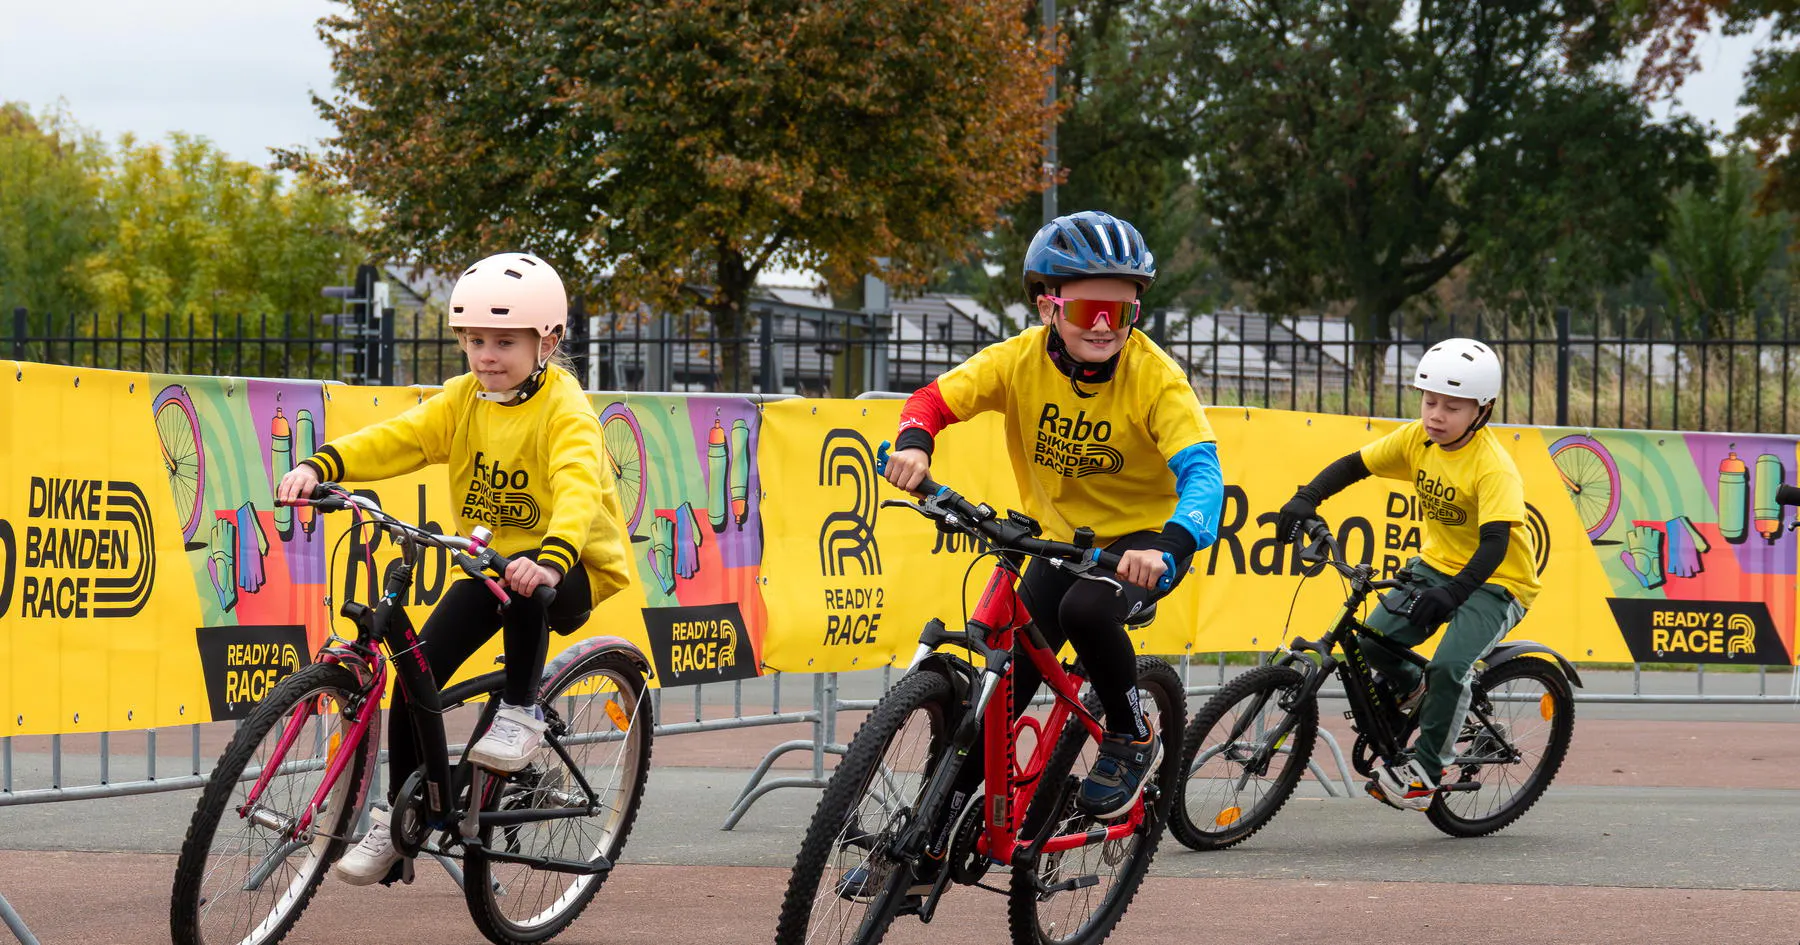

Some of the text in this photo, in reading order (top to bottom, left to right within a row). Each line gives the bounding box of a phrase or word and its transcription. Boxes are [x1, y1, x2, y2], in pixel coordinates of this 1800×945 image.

[1038, 402, 1112, 443] Rabo
[1035, 441, 1104, 467] BANDEN
[1037, 430, 1083, 456] DIKKE
[1034, 453, 1074, 478] RACE
[28, 476, 103, 521] DIKKE
[469, 479, 501, 503] DIKKE
[1416, 469, 1456, 502] Rabo
[461, 506, 499, 527] RACE
[464, 492, 522, 518] BANDEN
[25, 526, 129, 570] BANDEN
[21, 576, 90, 619] RACE
[824, 586, 884, 610] READY 2
[672, 620, 718, 640] READY 2
[823, 613, 882, 646] RACE
[1652, 611, 1724, 628] READY 2
[1652, 628, 1724, 653] RACE
[227, 643, 279, 666] READY 2
[671, 642, 717, 672] RACE
[226, 669, 277, 703] RACE
